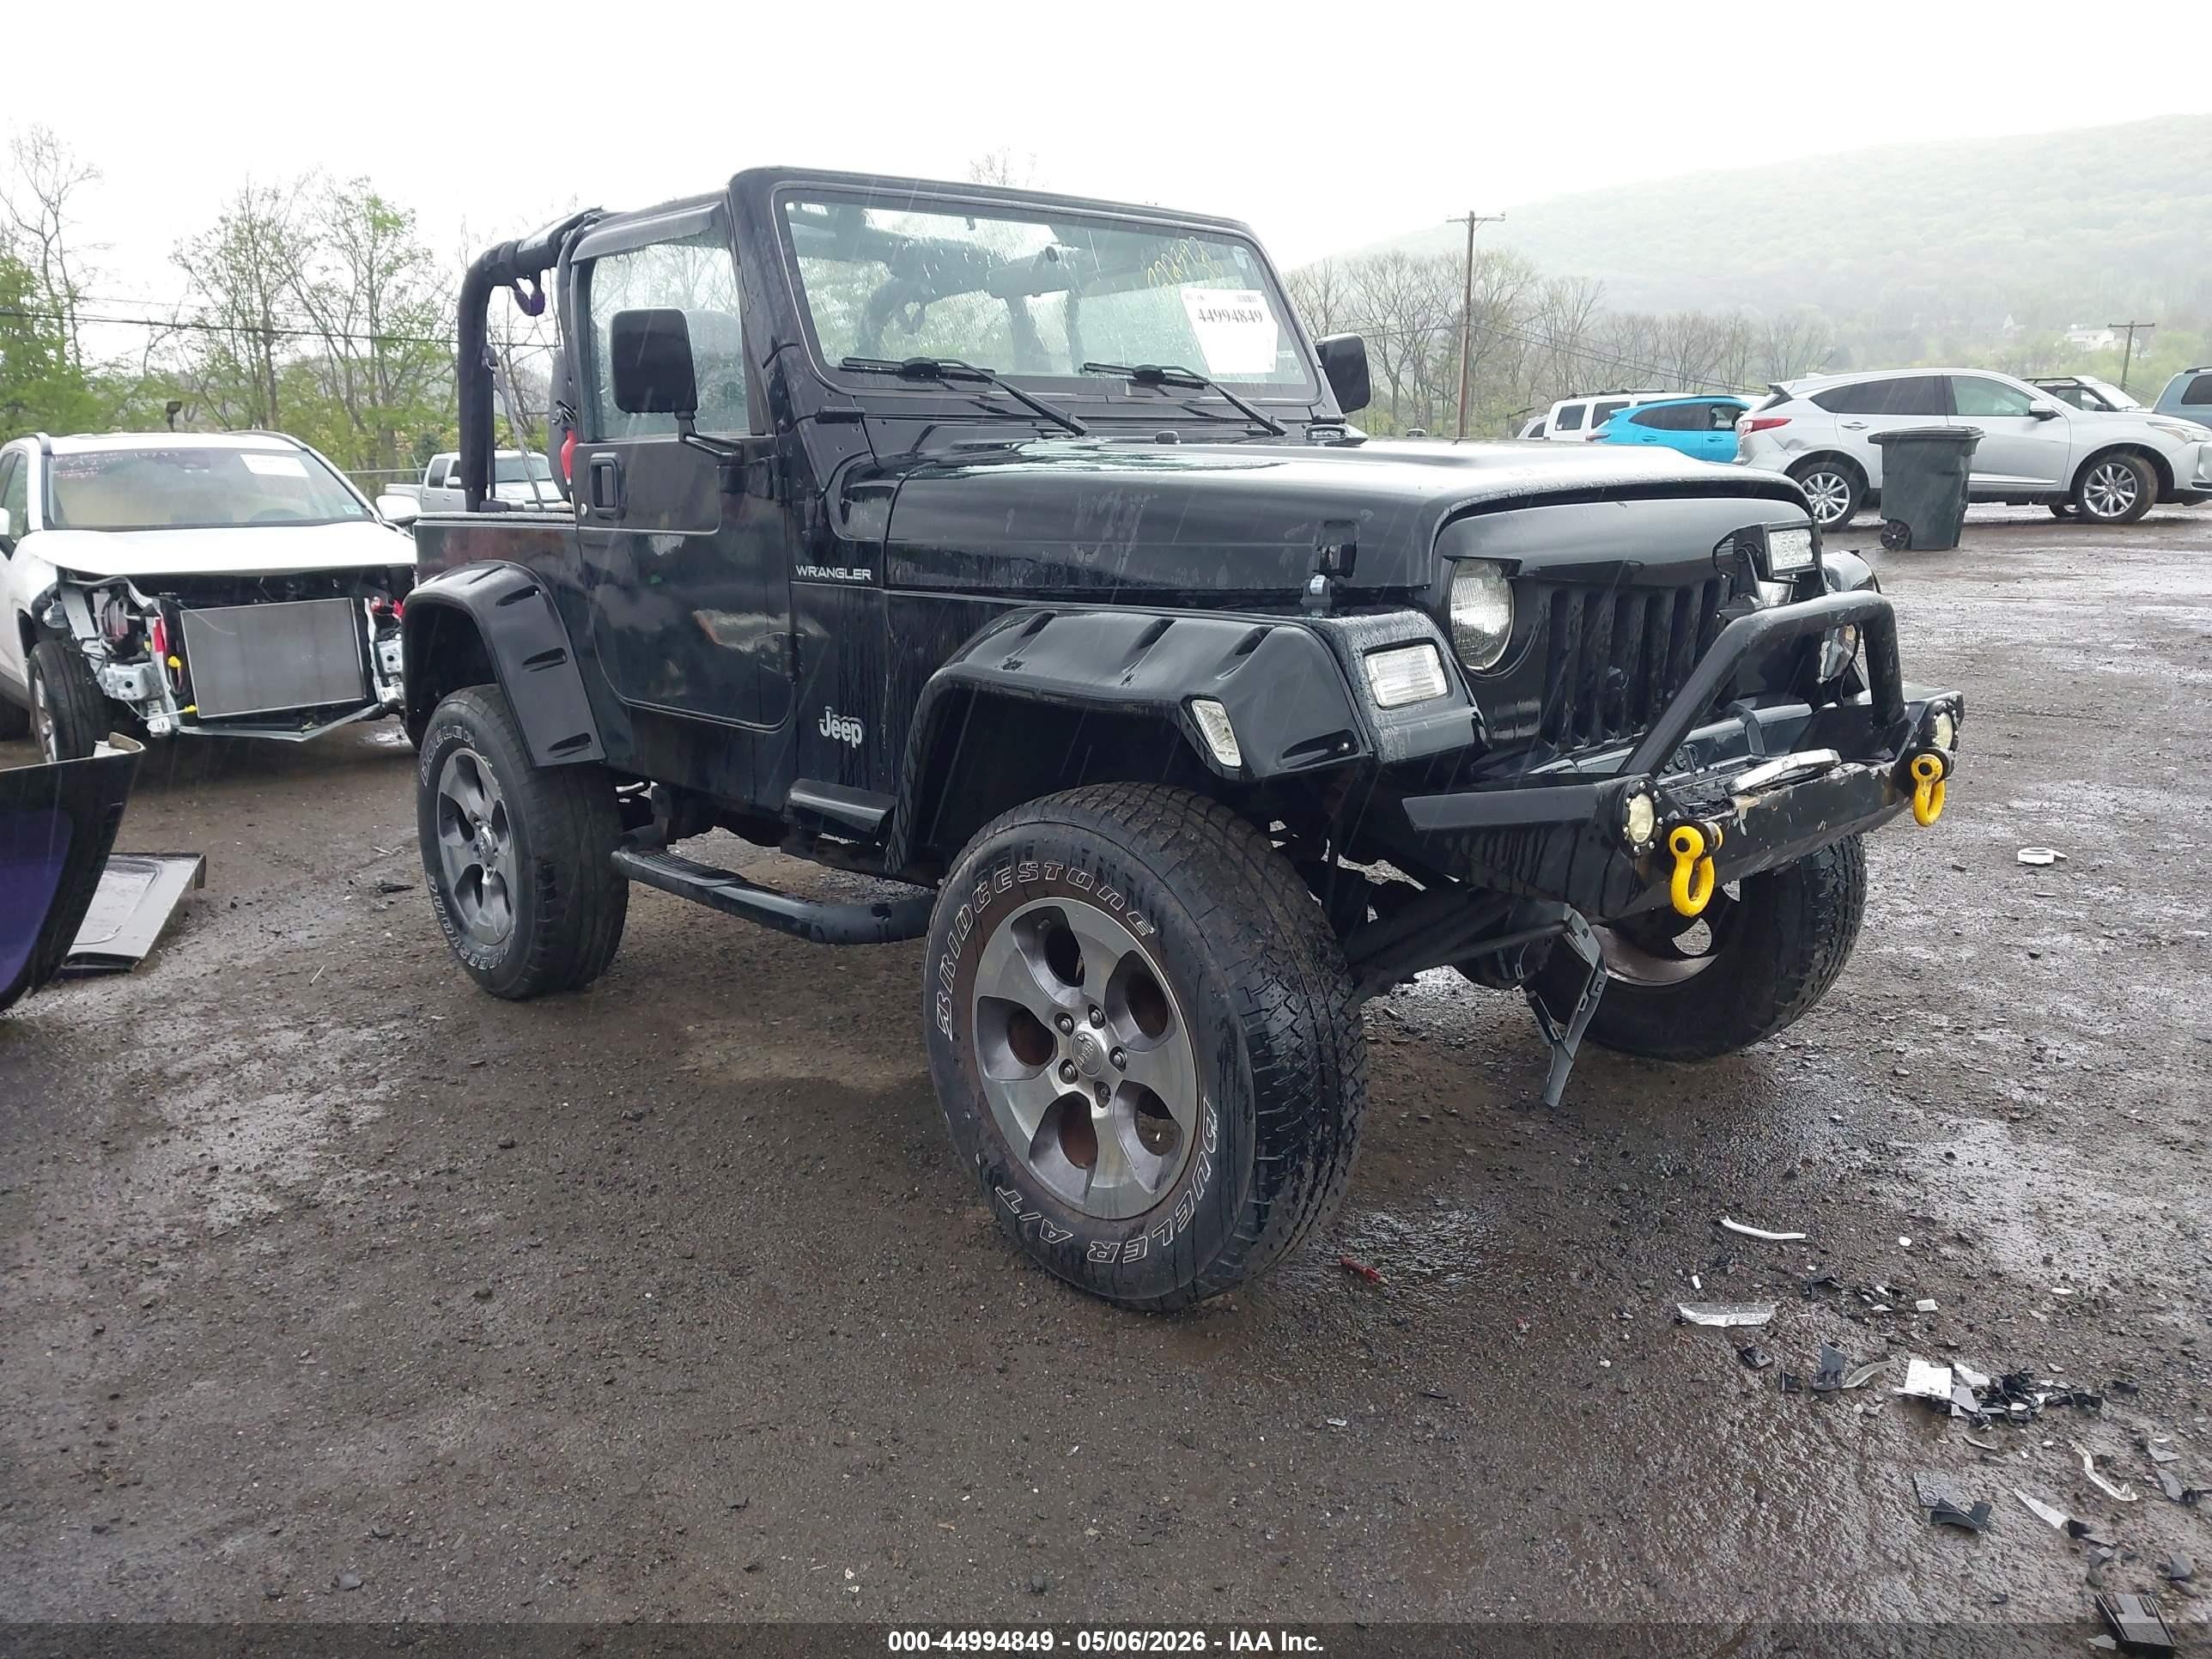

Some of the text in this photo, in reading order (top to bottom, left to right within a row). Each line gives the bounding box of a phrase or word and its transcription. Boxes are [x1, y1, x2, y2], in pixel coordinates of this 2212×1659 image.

[1198, 308, 1263, 323] 44994849
[795, 564, 872, 580] WRANGLER
[818, 706, 865, 749] Jeep
[936, 860, 1158, 1042] BRIDGESTONE
[994, 1097, 1220, 1264] DUELER A/T
